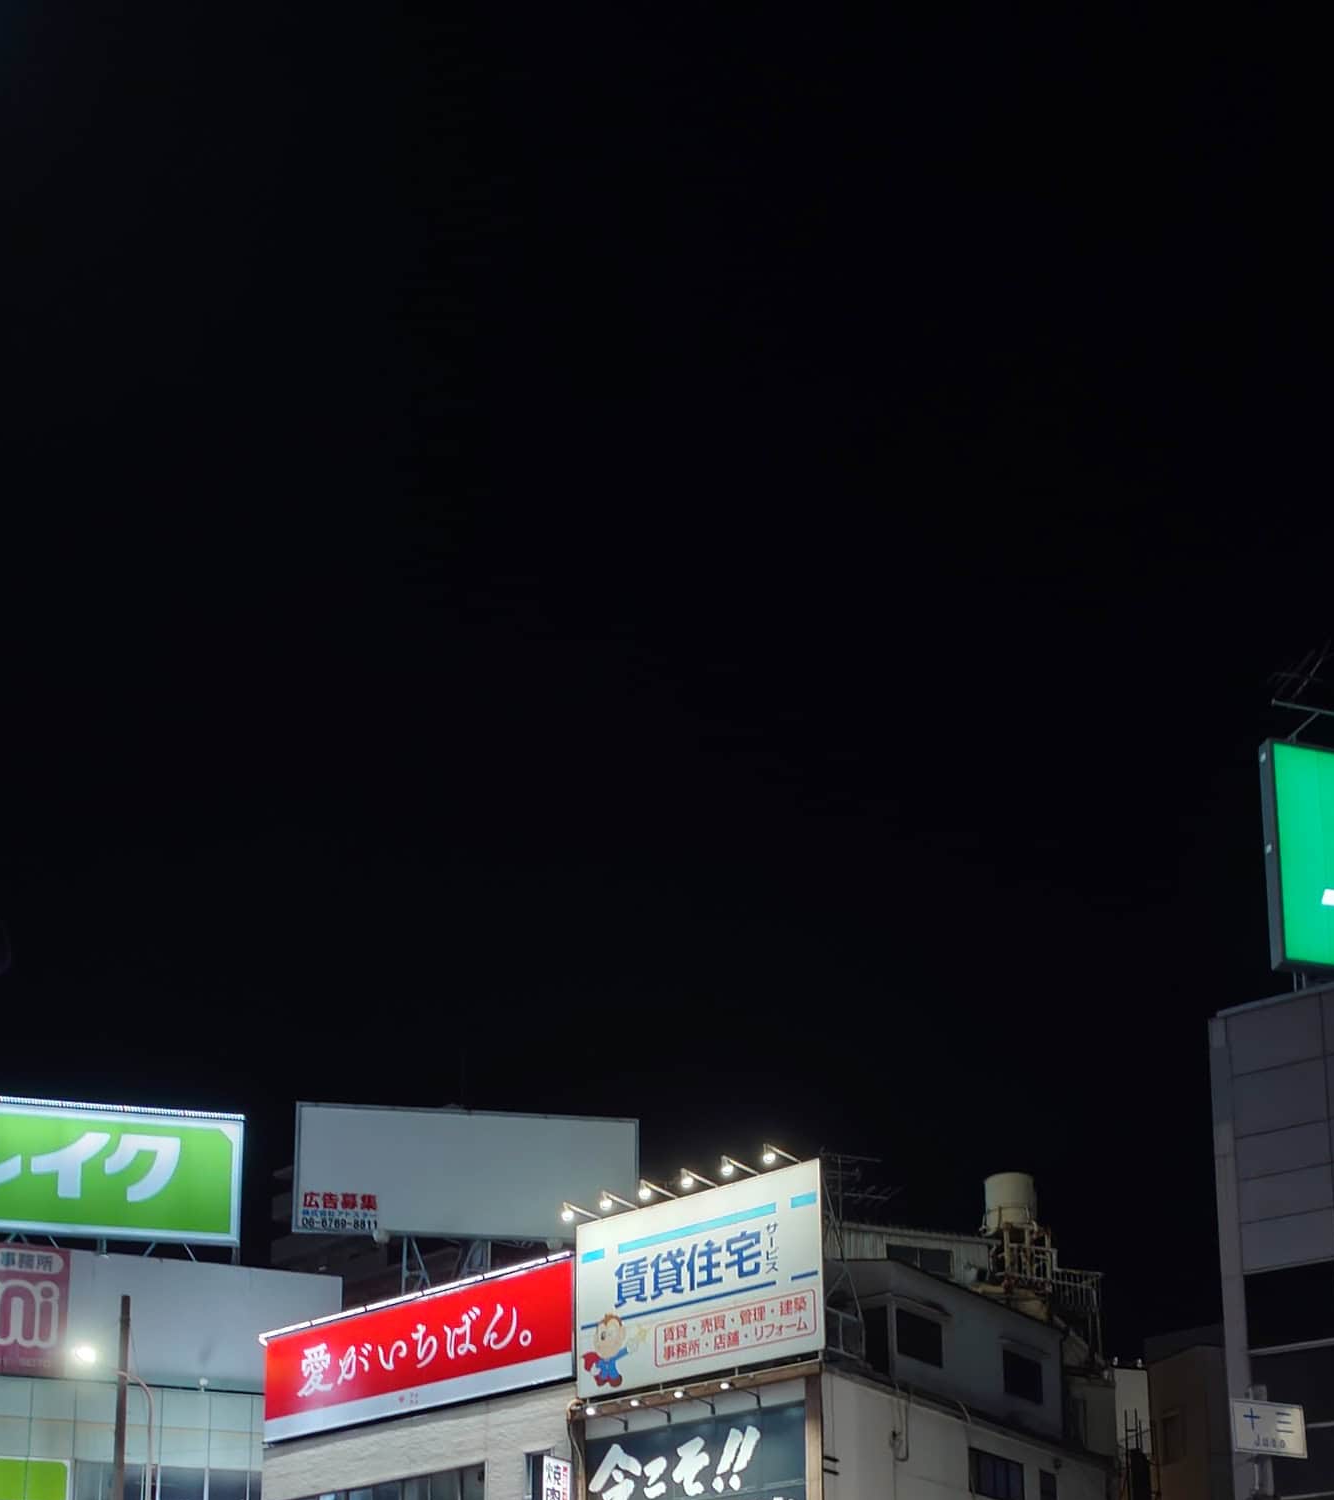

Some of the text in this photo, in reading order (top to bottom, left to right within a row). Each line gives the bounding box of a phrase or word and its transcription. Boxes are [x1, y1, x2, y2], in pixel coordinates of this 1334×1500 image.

[302, 1192, 378, 1211] 広告募集
[613, 1221, 779, 1309] 賃貸住宅 サービス
[297, 1303, 532, 1398] 愛がいちばん。
